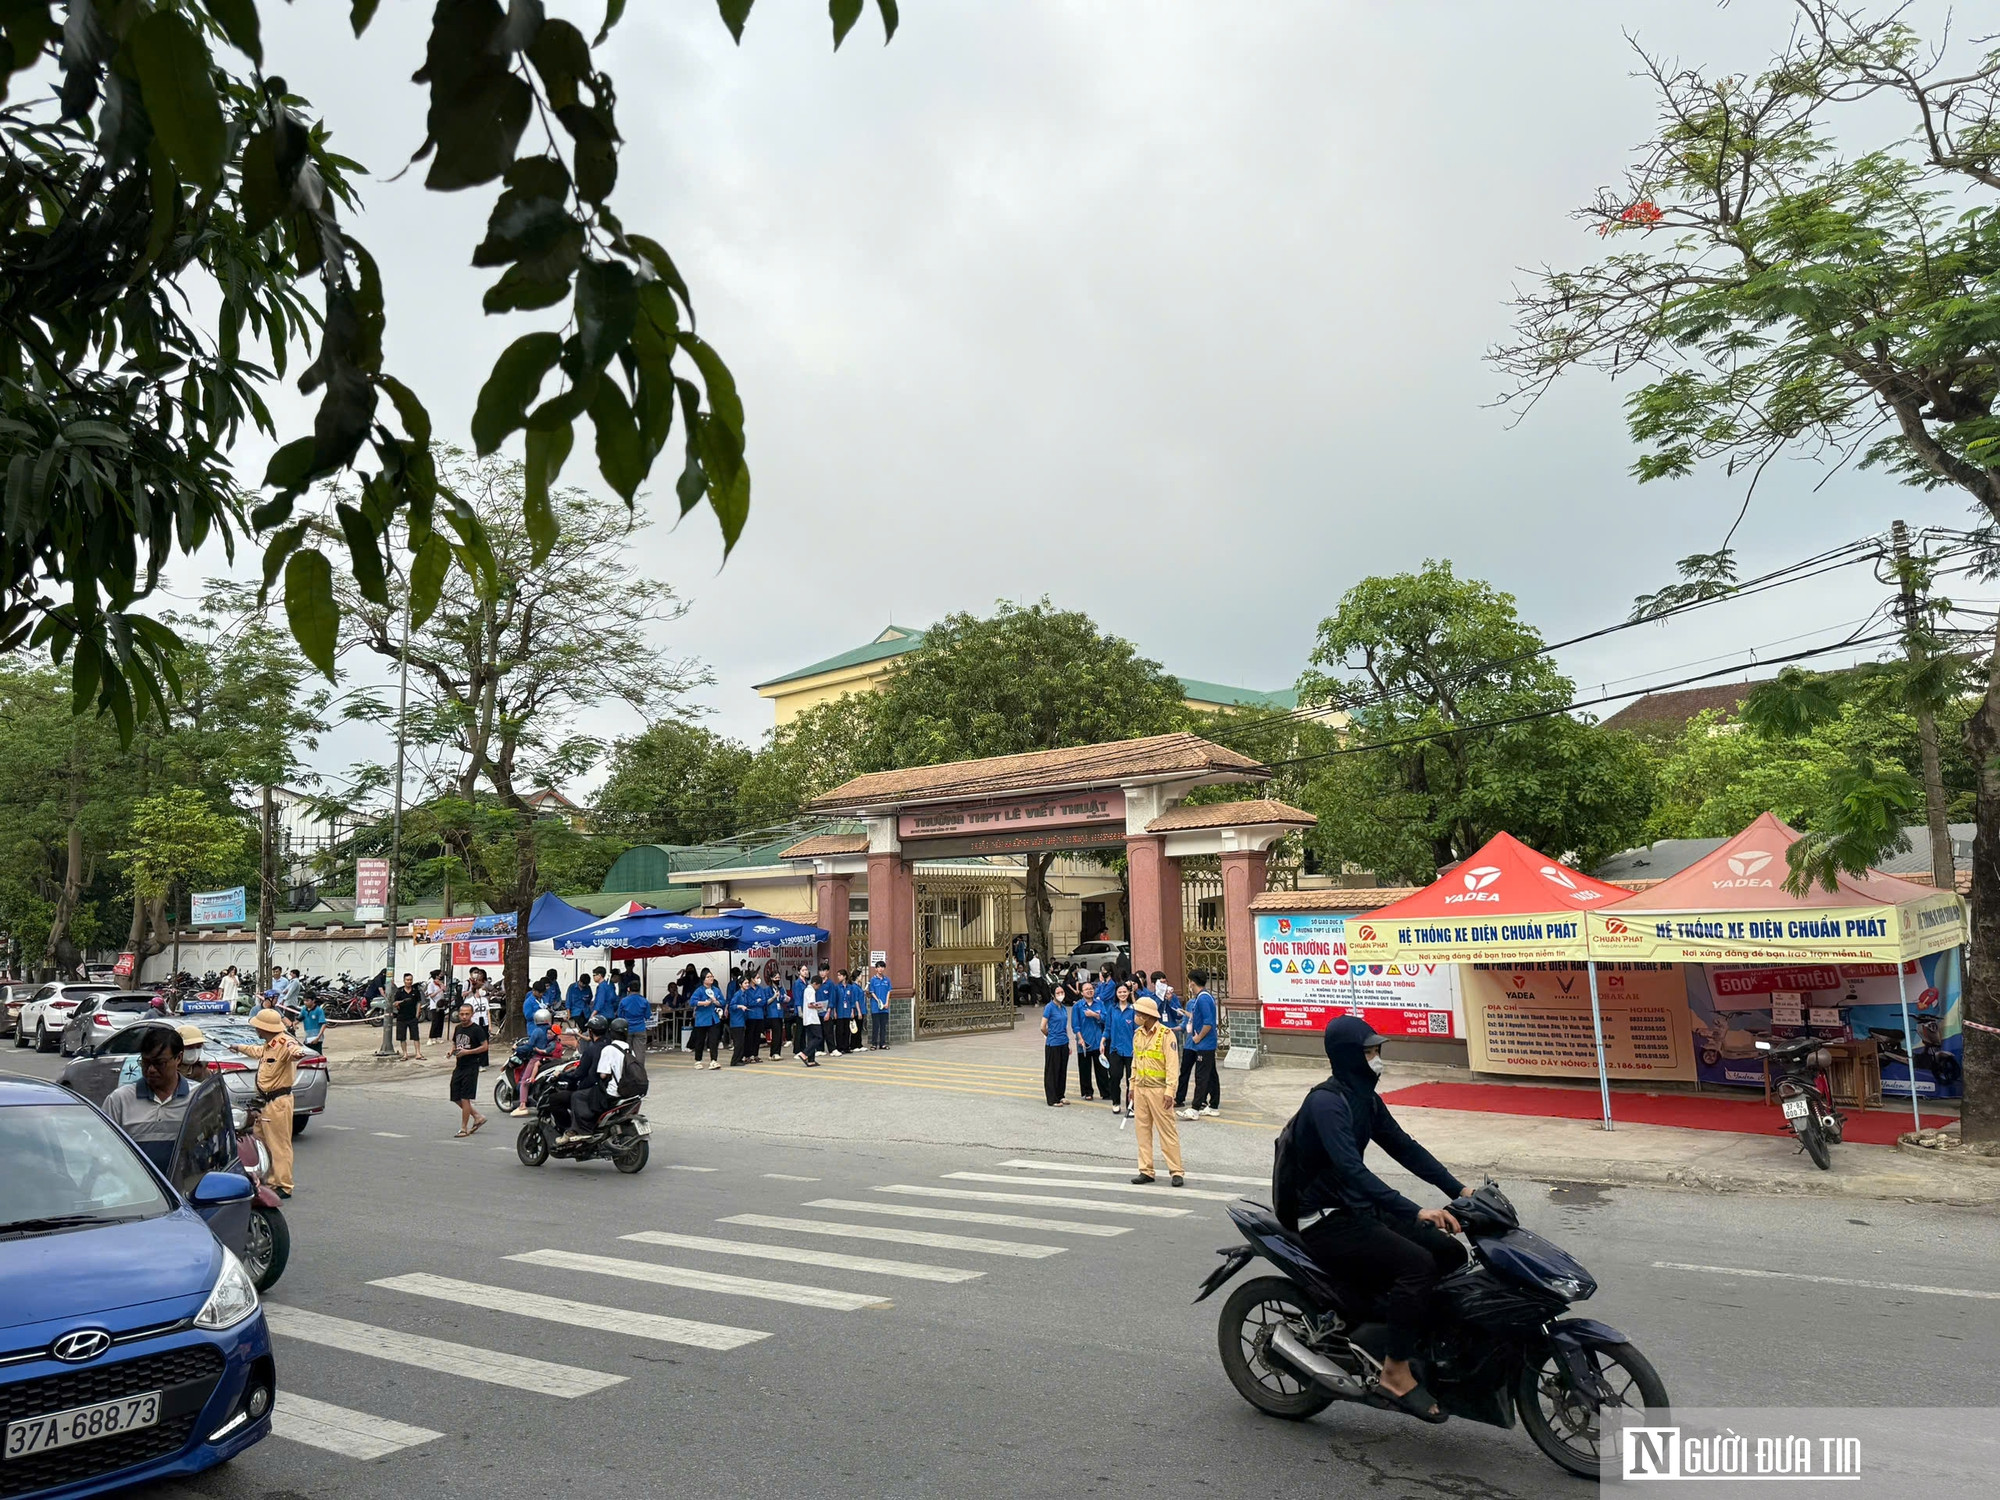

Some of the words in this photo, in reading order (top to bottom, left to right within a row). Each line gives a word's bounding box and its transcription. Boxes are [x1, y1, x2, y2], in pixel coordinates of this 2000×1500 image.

[914, 813, 964, 827] TRƯỜNG
[968, 812, 1001, 824] THPT
[1004, 808, 1021, 820] LÊ
[1025, 802, 1056, 818] VIẾT
[1060, 800, 1108, 815] THUẬT
[1712, 878, 1773, 889] YADEA
[1444, 892, 1500, 904] YADEA
[1569, 890, 1603, 901] YADEA
[1398, 926, 1412, 946] HỆ
[1414, 924, 1451, 943] THỐNG
[1455, 927, 1468, 942] XE
[1472, 924, 1498, 944] ĐIỆN
[1502, 919, 1542, 940] CHUẨN
[1547, 920, 1578, 939] PHÁT
[1656, 921, 1672, 941] HỆ
[1676, 917, 1724, 939] THỐNG
[1728, 922, 1744, 939] XE
[1750, 919, 1783, 942] ĐIỆN
[1788, 914, 1841, 938] CHUẨN
[1846, 916, 1886, 937] PHÁT
[694, 930, 723, 939] 19008010
[785, 935, 810, 944] 19008010
[1264, 937, 1289, 956] CỔNG
[1291, 939, 1330, 956] TRƯỜNG
[1333, 942, 1347, 956] AN
[1432, 952, 1450, 961] xứng
[1452, 951, 1471, 961] đáng
[1473, 950, 1482, 959] để
[1484, 952, 1499, 960] bạn
[1700, 948, 1722, 958] xứng
[1725, 949, 1749, 958] đáng
[1751, 949, 1763, 957] để
[1766, 950, 1785, 958] bạn
[1810, 950, 1829, 959] trọn
[1832, 948, 1857, 958] niềm
[1661, 962, 1672, 971] AN
[1860, 965, 1880, 974] QUÀ
[1775, 975, 1782, 988] 1
[1787, 970, 1836, 989] TRIỆU
[1541, 1057, 1558, 1066] DÂY
[1561, 1059, 1590, 1068] NÓNG:
[9, 1398, 156, 1454] 37A-688.73
